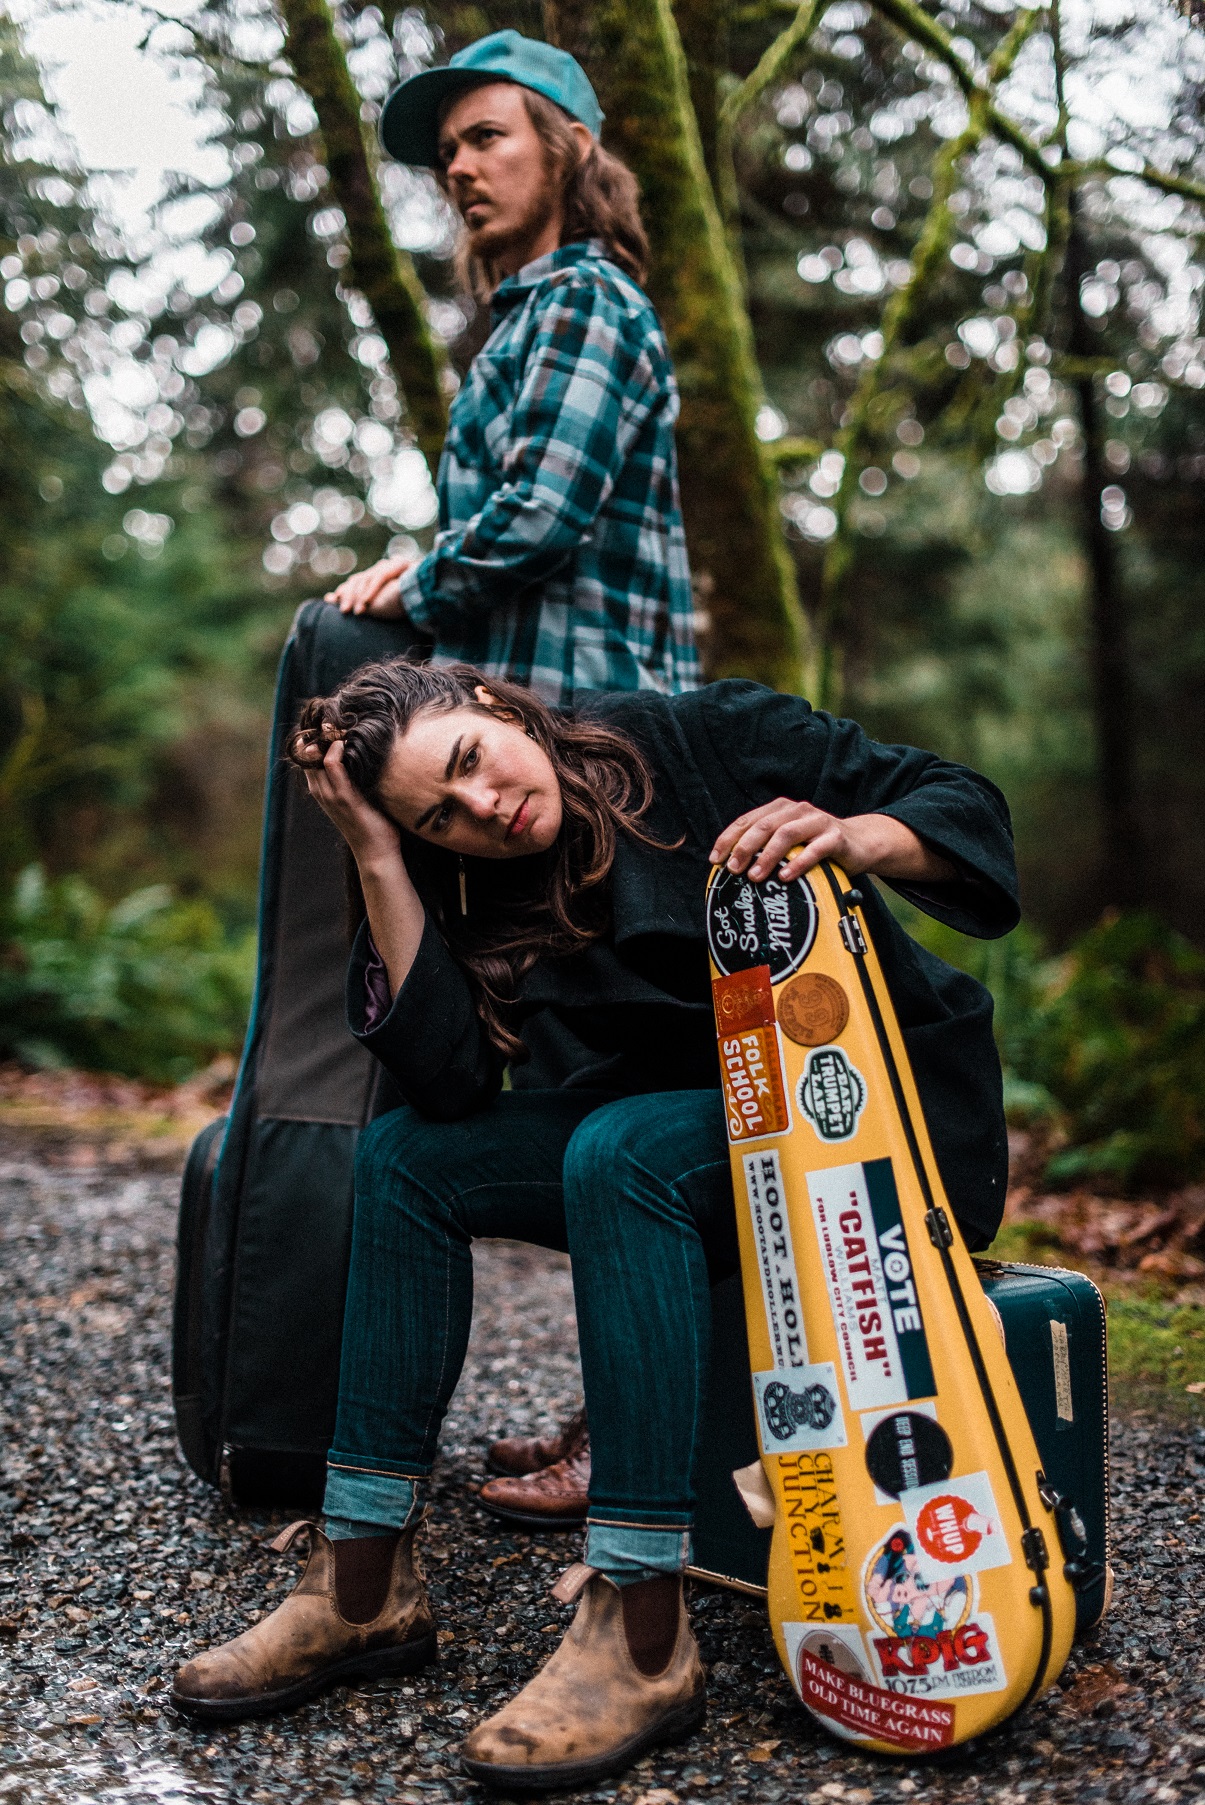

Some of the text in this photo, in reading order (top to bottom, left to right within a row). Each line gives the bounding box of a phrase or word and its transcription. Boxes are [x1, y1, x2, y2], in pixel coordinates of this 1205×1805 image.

[714, 906, 737, 949] Got
[734, 883, 759, 953] Snake
[763, 881, 792, 951] Milk?
[723, 1039, 764, 1132] SCHOOL
[741, 1034, 770, 1098] FOLK
[820, 1054, 844, 1135] TRUMPET
[837, 1072, 851, 1115] EAR
[761, 1157, 787, 1259] HOOT
[815, 1197, 827, 1224] FOR
[821, 1226, 838, 1283] LUDLOW
[839, 1190, 892, 1377] "CATFISH"
[879, 1224, 921, 1334] VOTE
[833, 1244, 859, 1331] WILLIAMS
[834, 1287, 845, 1317] CITY
[839, 1322, 857, 1381] COUNCIL
[894, 1416, 911, 1436] DEEP
[898, 1438, 914, 1456] END
[797, 1454, 823, 1518] CITY
[814, 1453, 845, 1559] CHARM
[778, 1455, 825, 1622] JUNCTION
[934, 1503, 965, 1556] WHUP
[873, 1623, 992, 1677] KPIG
[804, 1658, 951, 1725] MAKE BLUEGRASS
[809, 1681, 838, 1705] OLD
[840, 1699, 881, 1725] TIME
[884, 1718, 943, 1743] AGAIN
